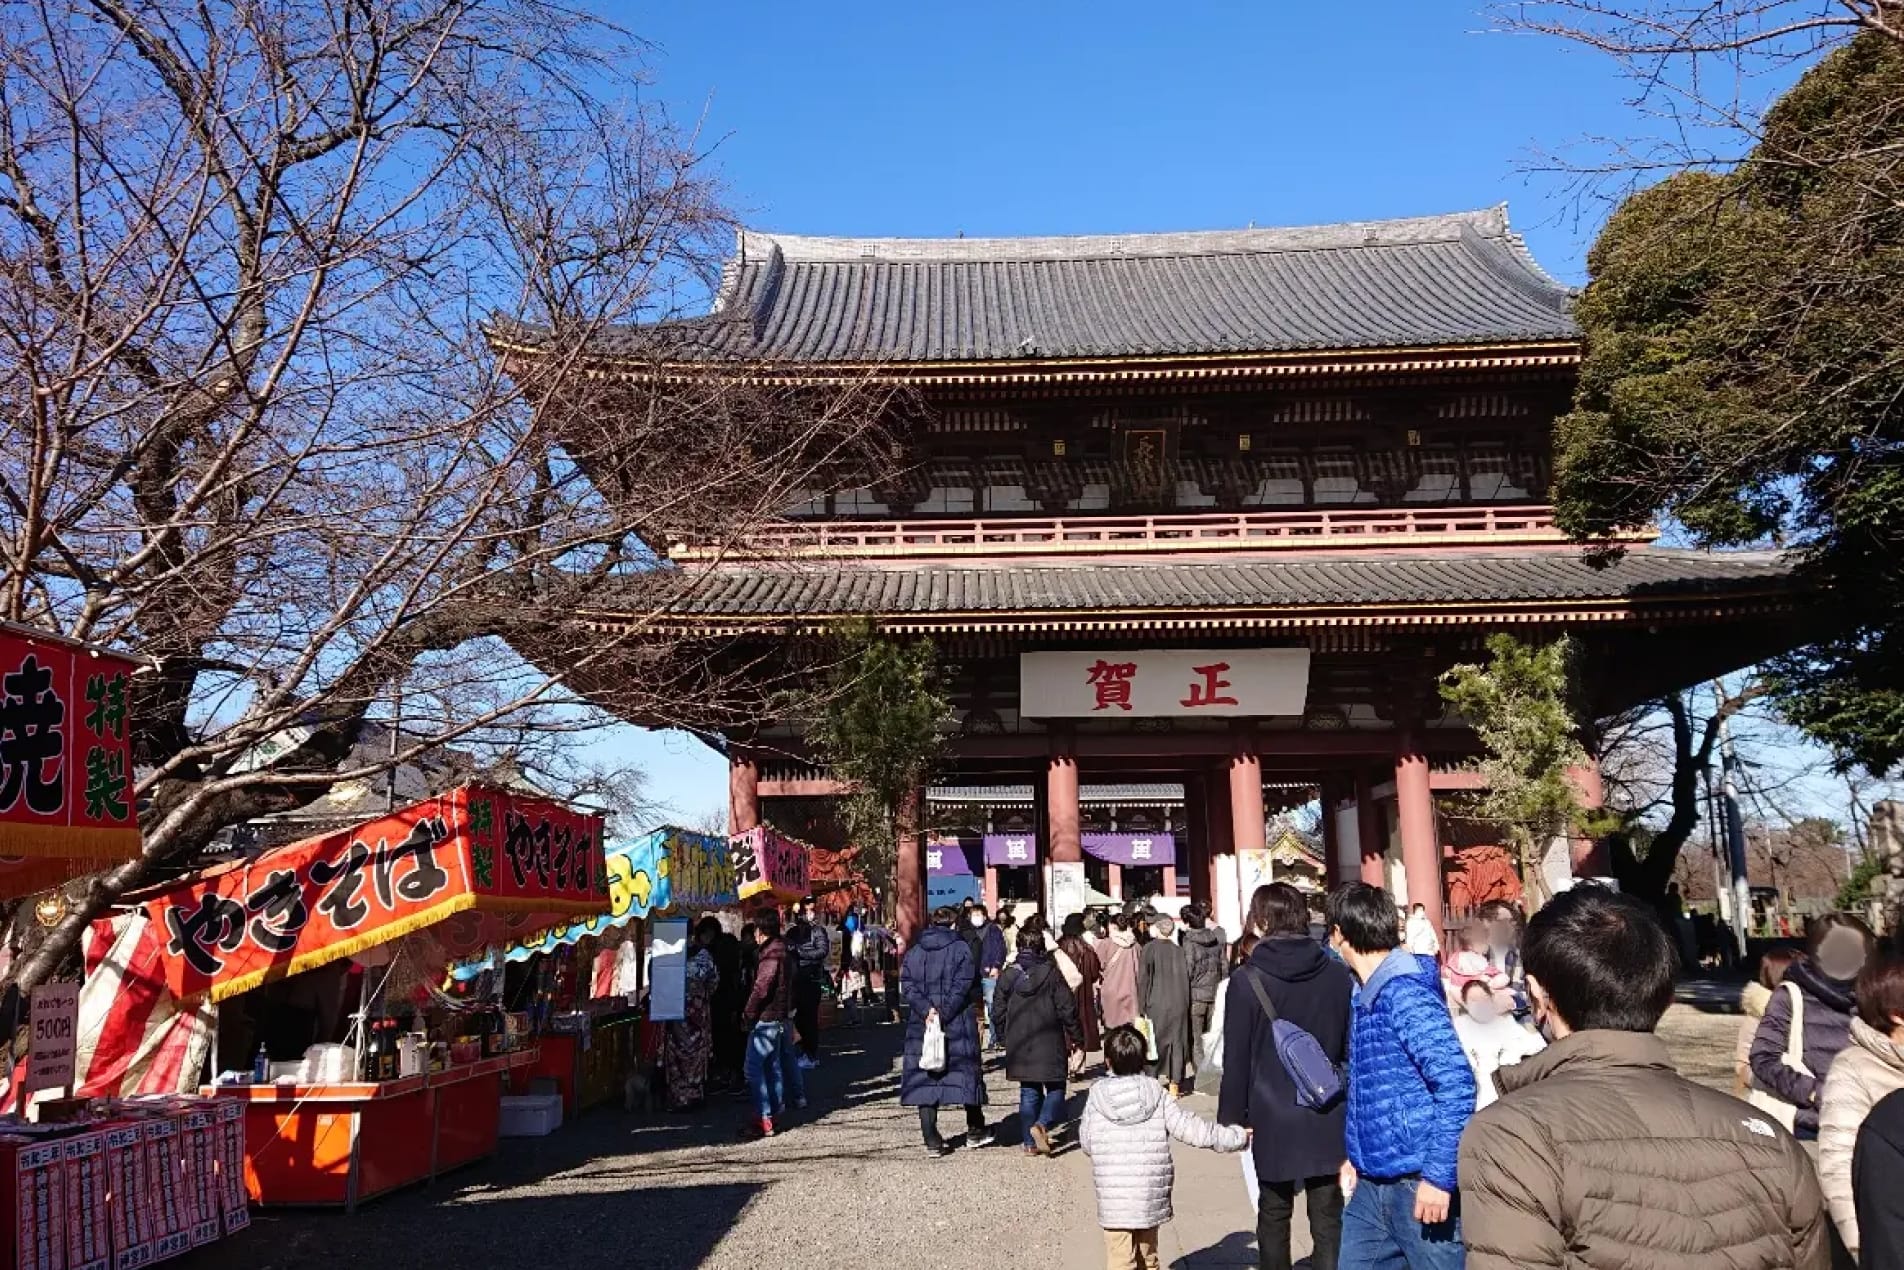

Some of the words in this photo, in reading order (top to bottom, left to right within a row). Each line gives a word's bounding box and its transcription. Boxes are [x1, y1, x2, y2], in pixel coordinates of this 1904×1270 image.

[85, 671, 129, 821] 特製
[164, 817, 449, 976] やきそば
[504, 809, 590, 892] やきそば
